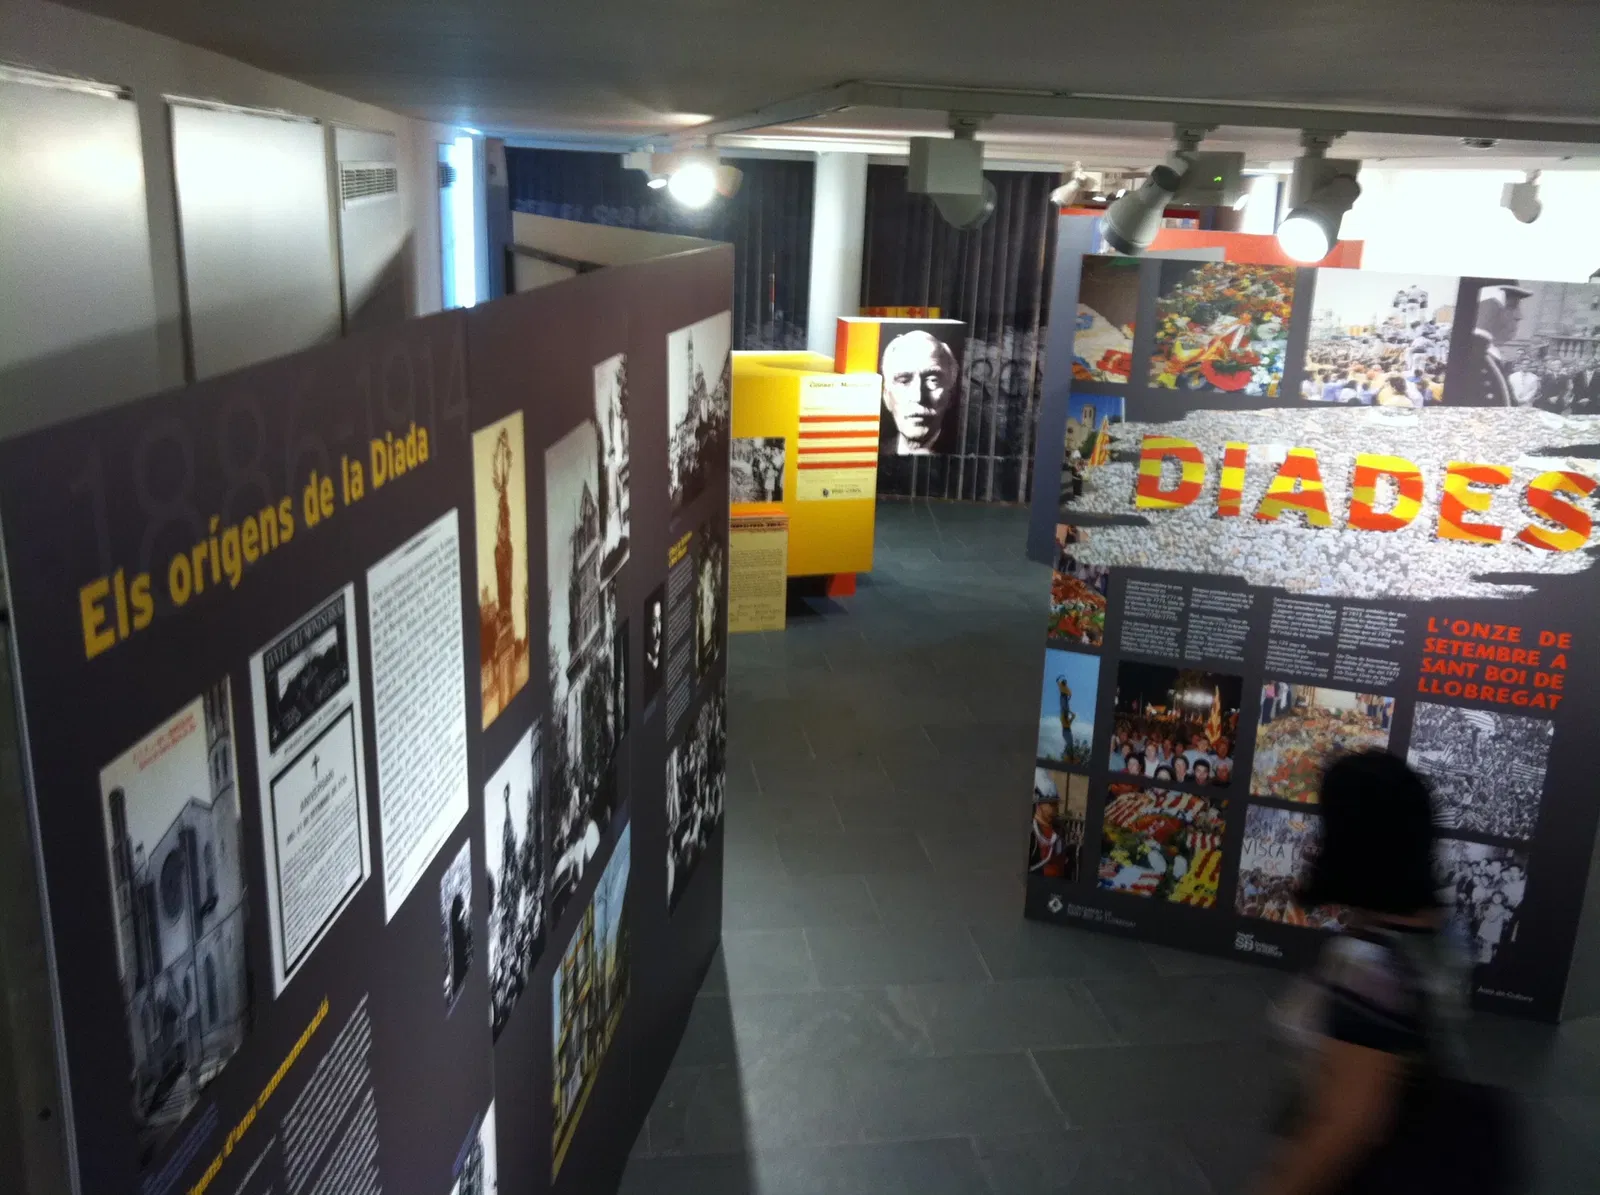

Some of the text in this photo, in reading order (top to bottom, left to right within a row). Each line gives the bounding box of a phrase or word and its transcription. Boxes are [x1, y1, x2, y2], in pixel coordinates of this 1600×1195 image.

[1135, 434, 1598, 552] DIADES
[79, 421, 430, 661] Els orígens de la Diada
[1427, 616, 1522, 643] L'ONZE
[1538, 630, 1573, 649] DE
[1423, 637, 1568, 670] SETEMBRE A
[1420, 657, 1479, 678] SANT
[1485, 664, 1527, 685] BOI
[1533, 671, 1565, 690] DE
[1417, 676, 1563, 710] LLOBREGAT
[1242, 841, 1285, 858] VISCA
